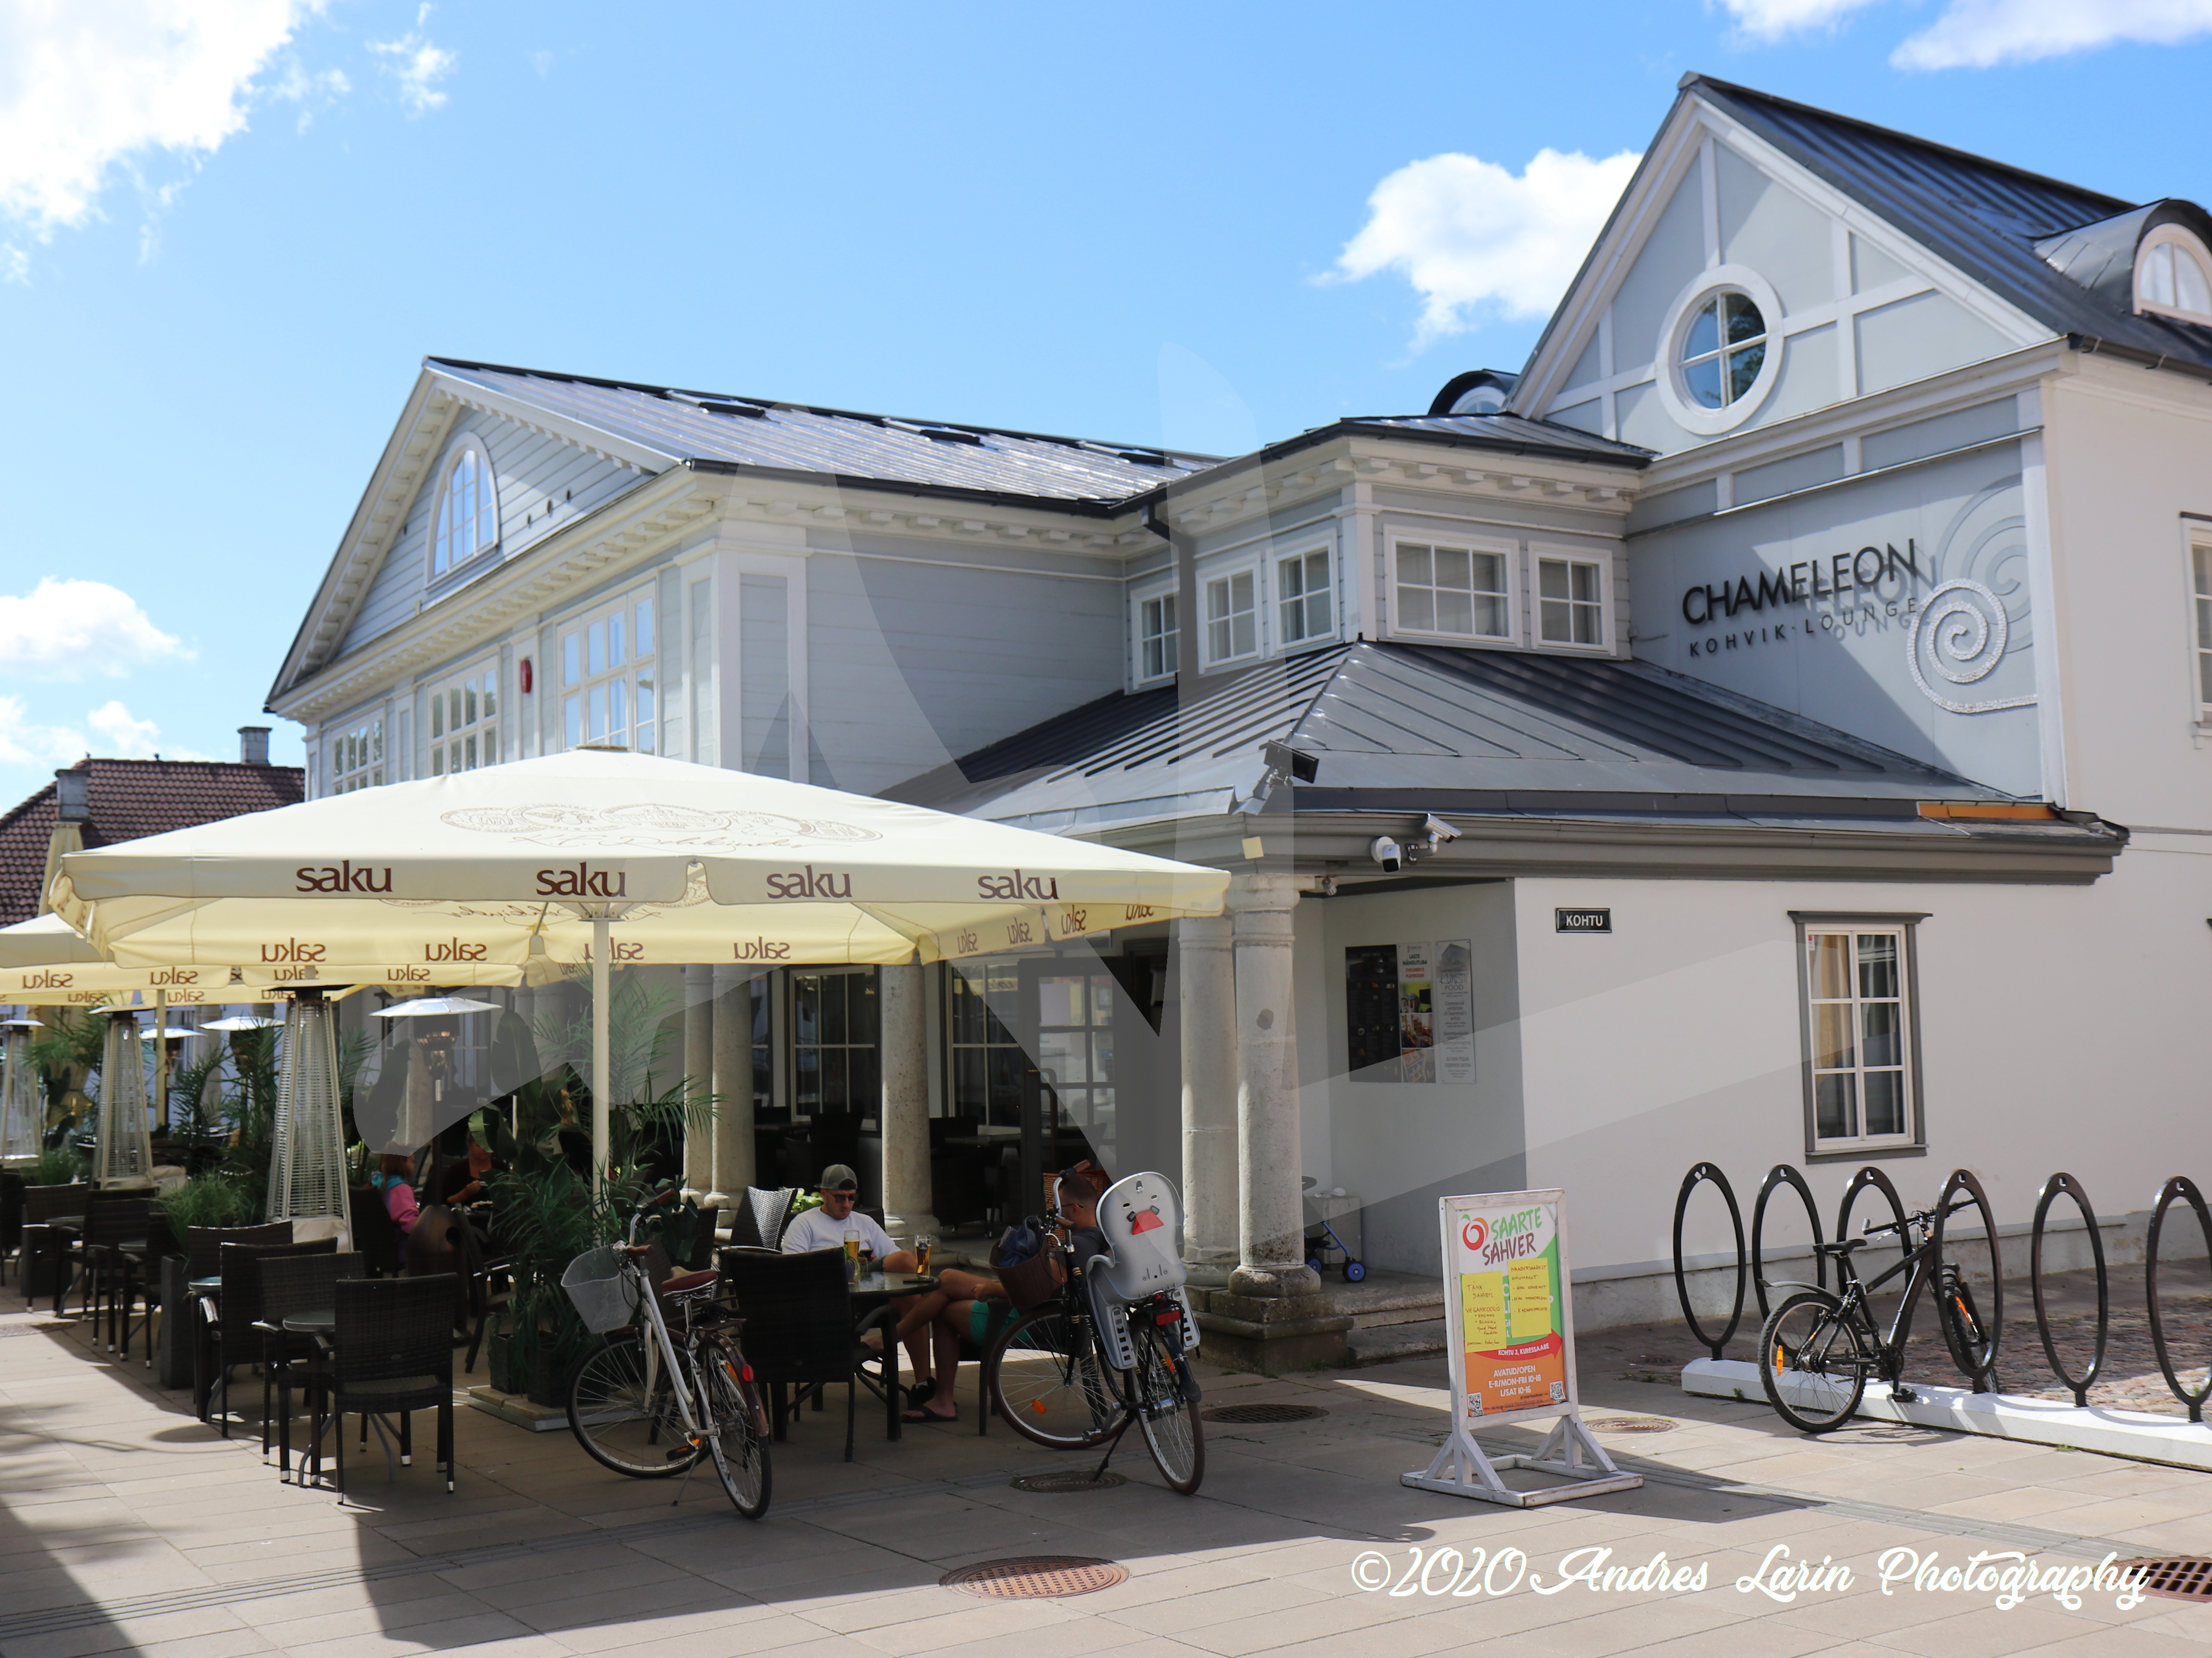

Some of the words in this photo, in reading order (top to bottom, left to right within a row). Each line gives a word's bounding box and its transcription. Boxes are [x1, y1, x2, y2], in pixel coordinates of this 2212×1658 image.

[1682, 538, 1917, 625] CHAMELEON
[1690, 624, 1787, 657] KOHVIK
[1805, 597, 1918, 634] LOUNGE
[296, 860, 393, 893] saku
[536, 862, 627, 897] saku
[766, 864, 852, 899] saku
[977, 869, 1060, 900] saku
[1566, 915, 1603, 927] KOHTU
[1490, 1207, 1542, 1241] SAARTE
[1482, 1233, 1536, 1266] SAHVER
[1519, 1343, 1550, 1354] KURESSAARE
[1488, 1376, 1527, 1389] E-R/MON-FRI
[1493, 1365, 1536, 1378] AVATUD/OPEN
[1500, 1388, 1517, 1397] L/SAT
[1518, 1386, 1531, 1394] 10-16
